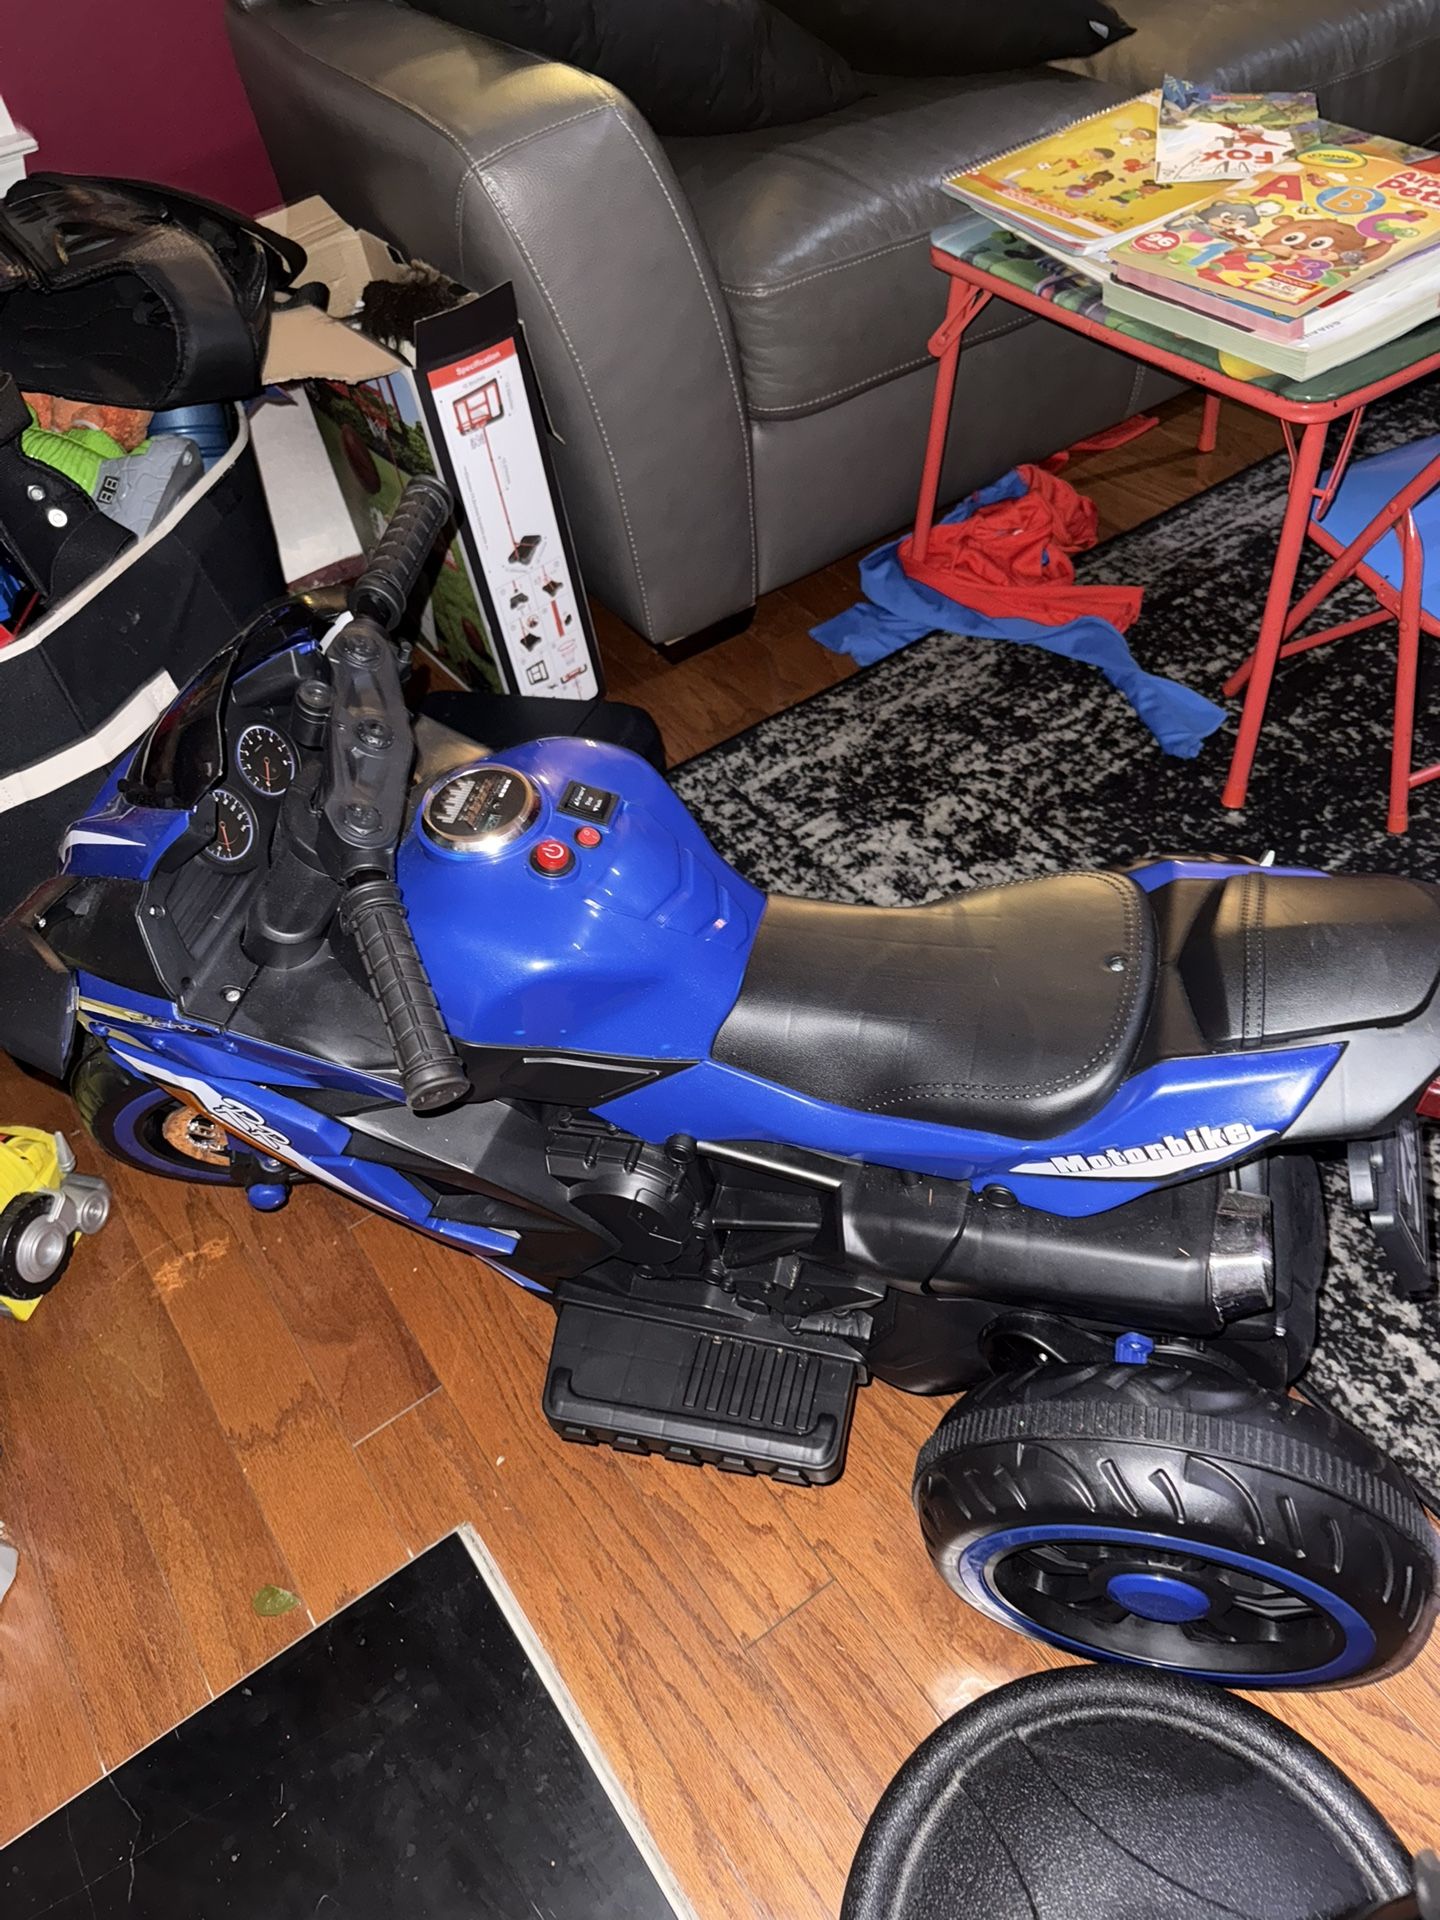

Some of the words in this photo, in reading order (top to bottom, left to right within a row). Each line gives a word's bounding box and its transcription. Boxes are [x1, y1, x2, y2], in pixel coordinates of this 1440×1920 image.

[1200, 149, 1274, 164] FOX
[1250, 174, 1304, 202] A
[1322, 187, 1374, 214] B
[1376, 179, 1440, 205] Pet
[1394, 172, 1440, 188] Alp
[1217, 261, 1275, 288] 2
[1283, 257, 1334, 281] 3
[1049, 1121, 1255, 1174] Motorbike
